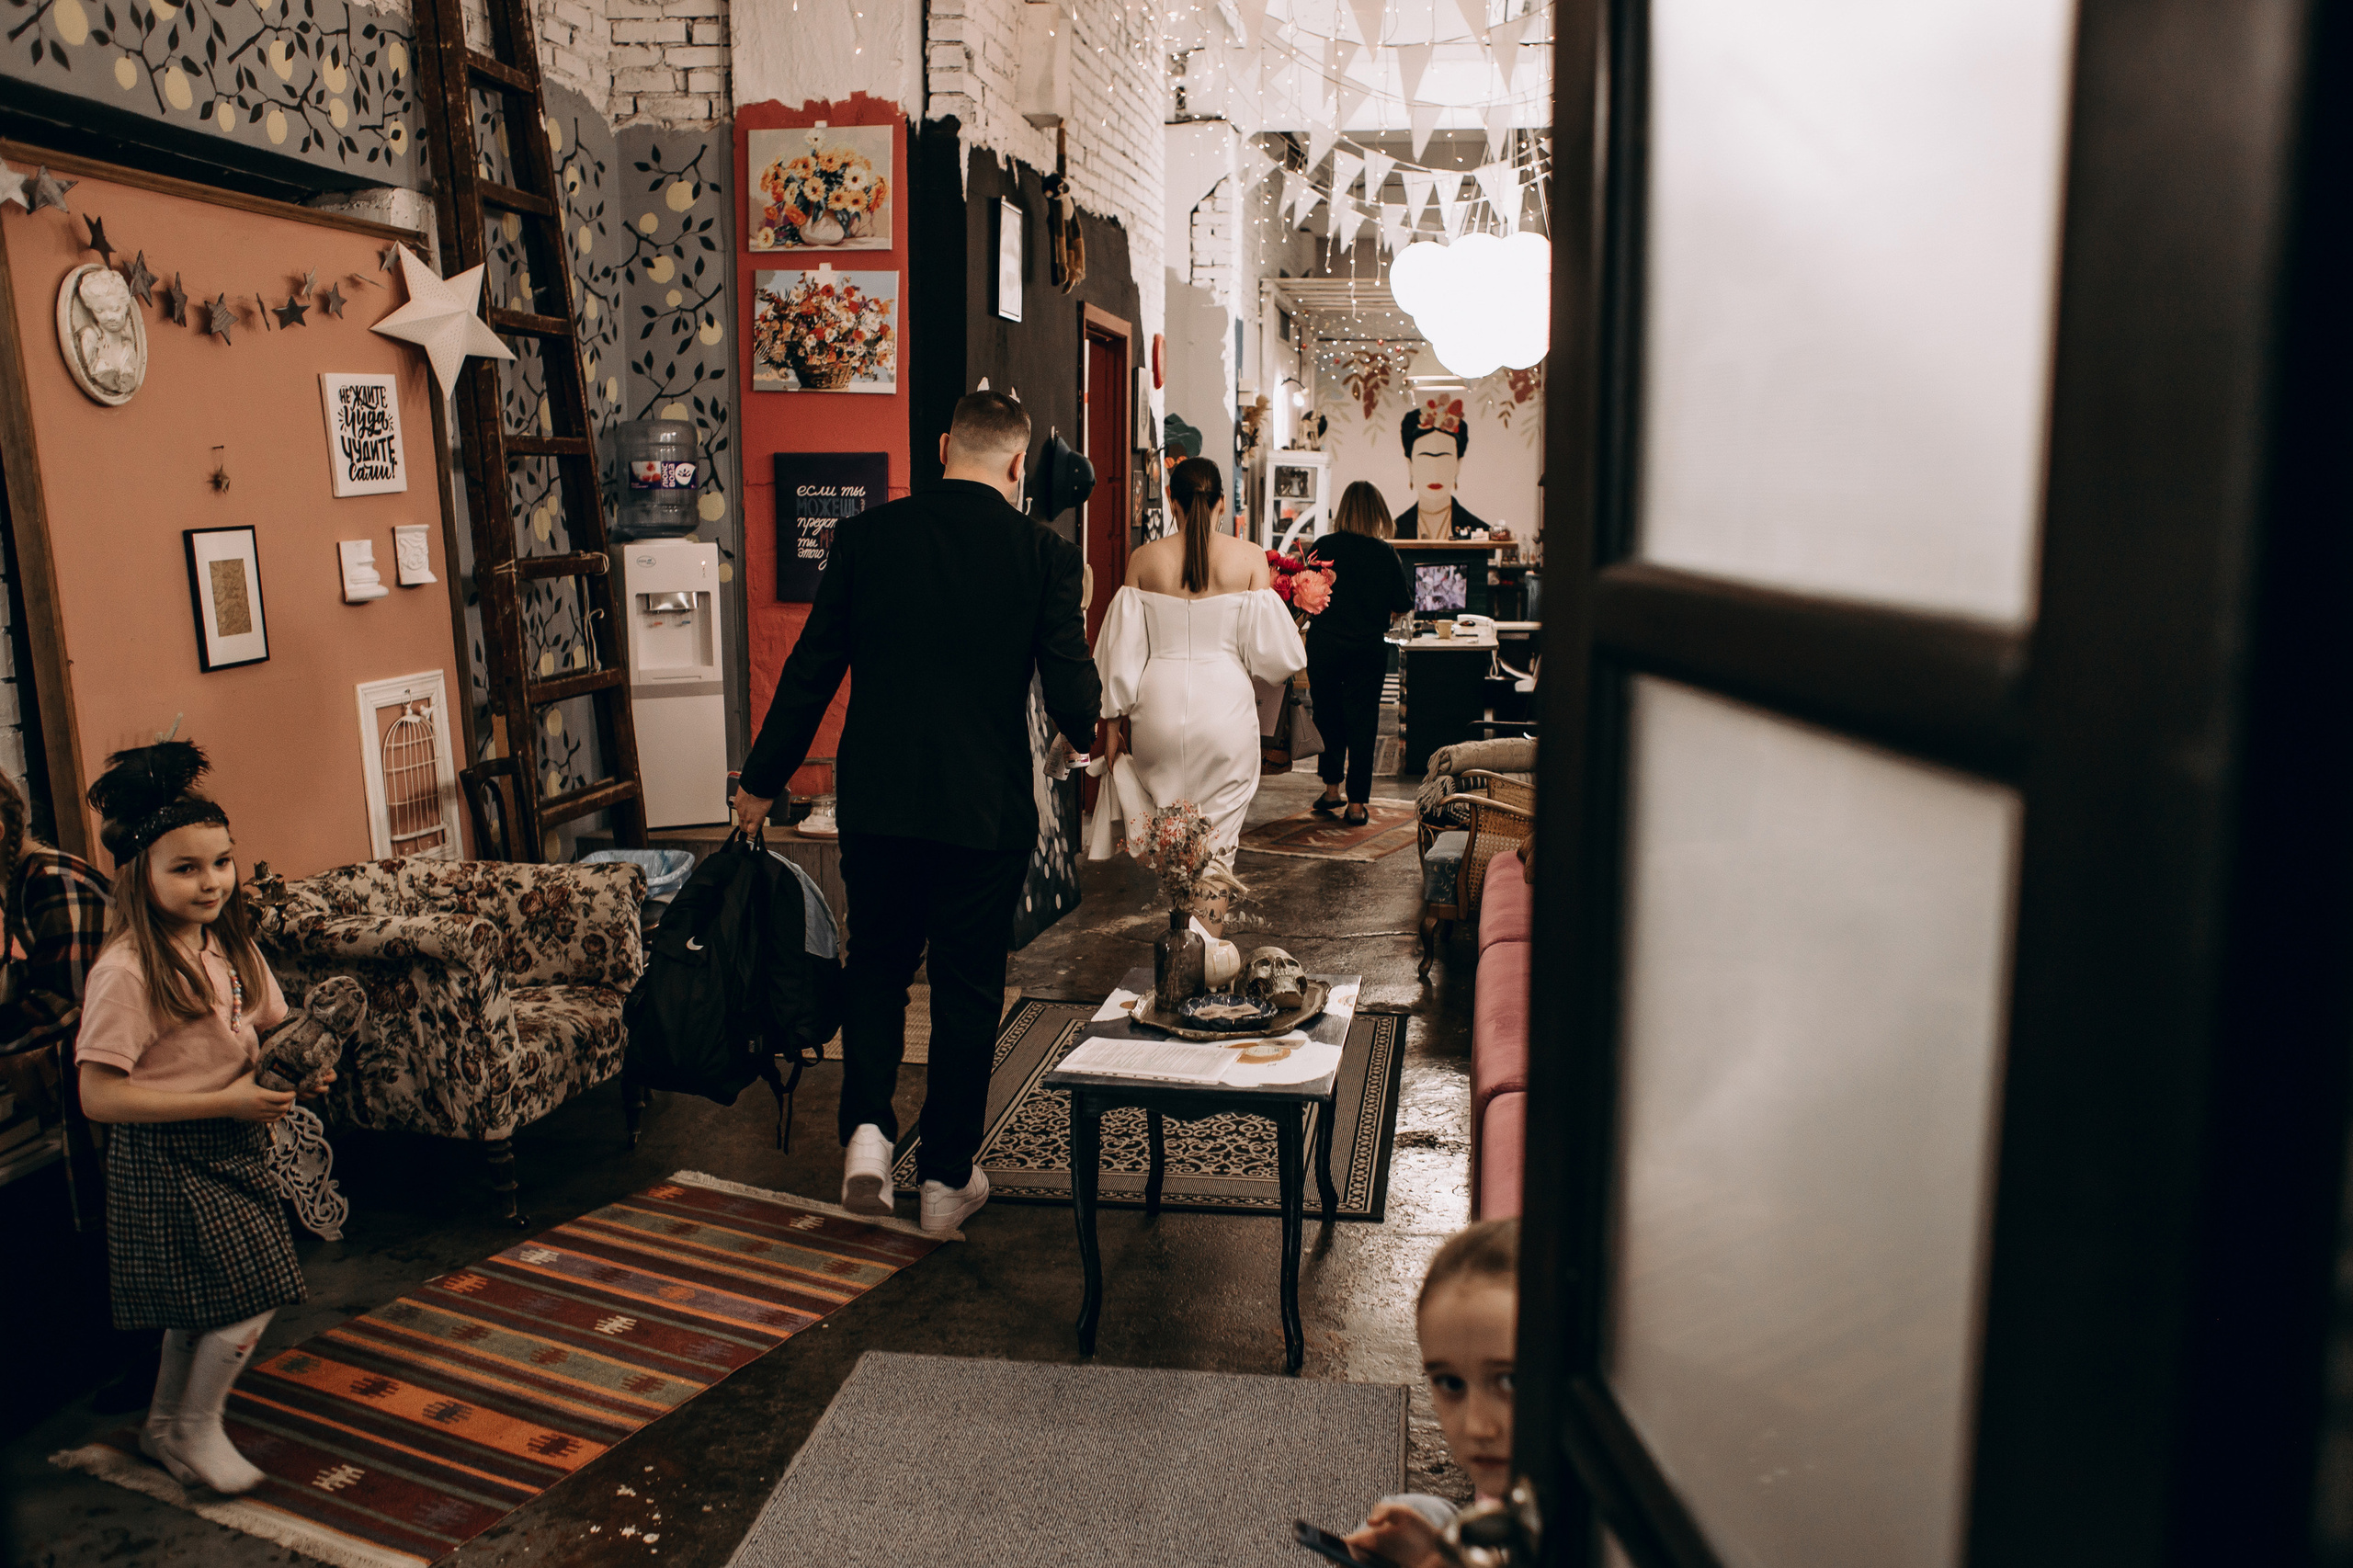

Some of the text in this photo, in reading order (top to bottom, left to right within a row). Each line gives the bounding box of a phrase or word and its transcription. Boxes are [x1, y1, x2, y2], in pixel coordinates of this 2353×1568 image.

[338, 385, 388, 411] НЕ ЖДИТЕ
[340, 434, 395, 464] ЧУДИТЕ
[796, 484, 866, 497] если ты
[796, 517, 839, 537] предст
[797, 538, 819, 548] ты
